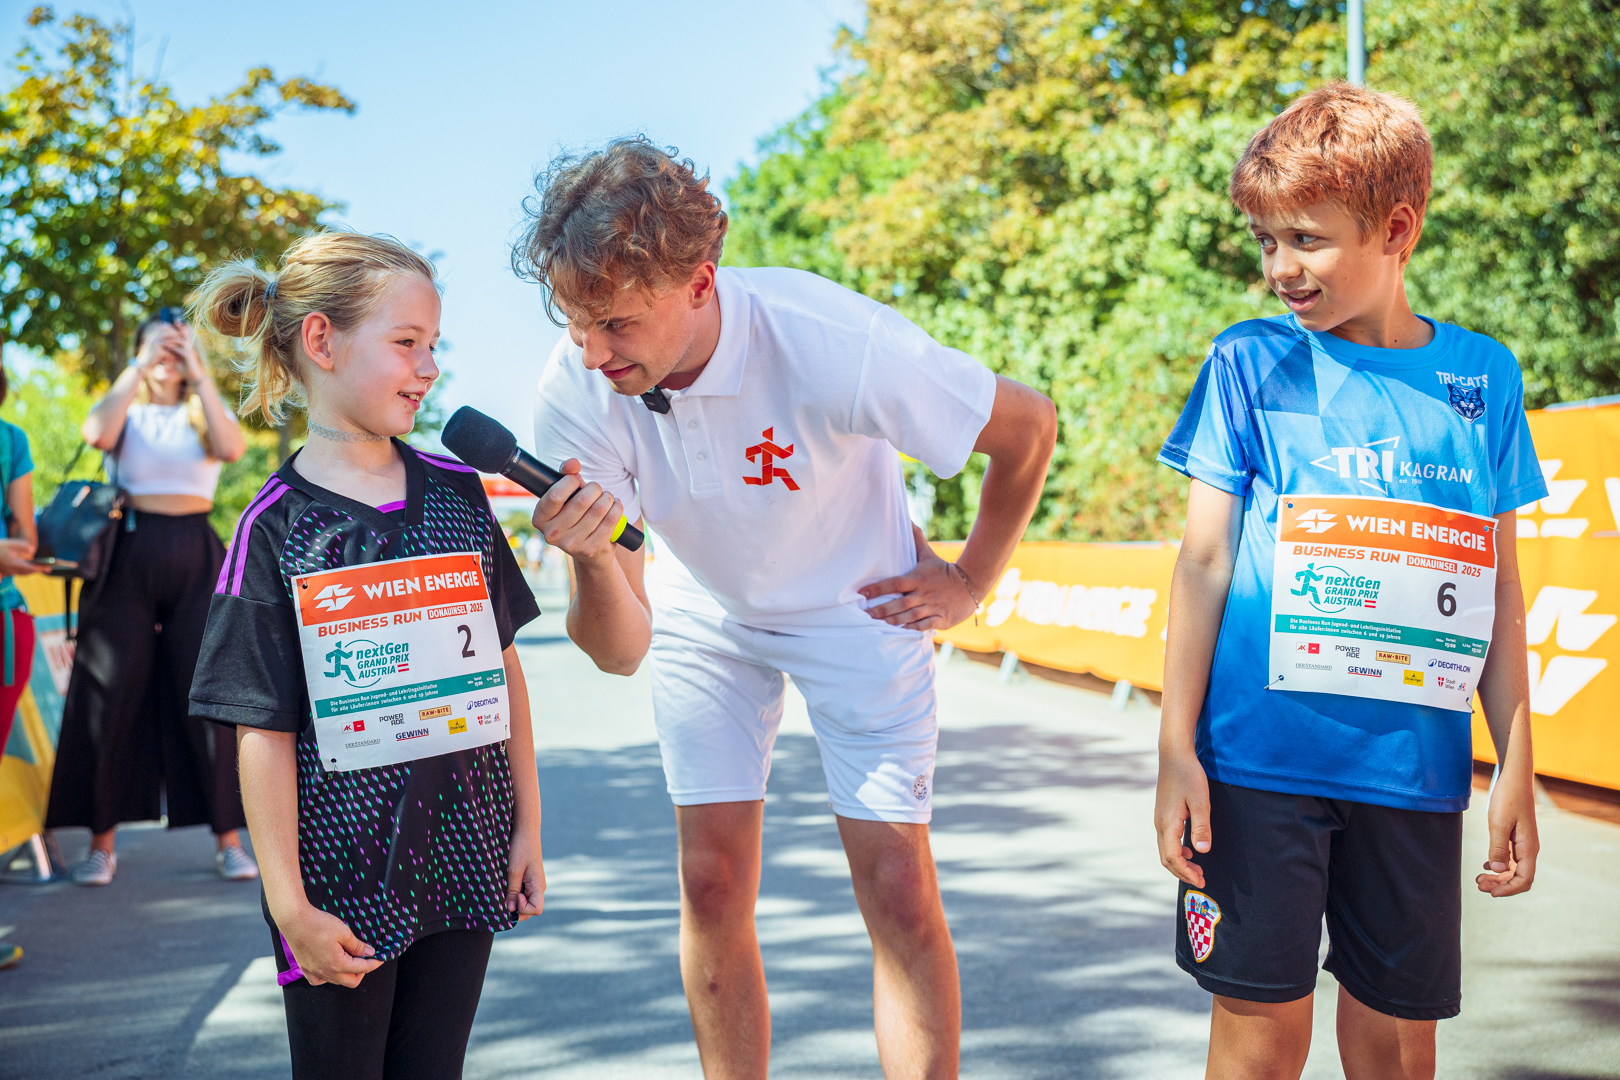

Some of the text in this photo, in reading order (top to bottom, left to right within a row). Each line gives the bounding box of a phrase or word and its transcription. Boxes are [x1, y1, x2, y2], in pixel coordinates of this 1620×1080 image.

[1436, 371, 1488, 389] TRI-CATS
[1331, 447, 1473, 484] TRI KAGRAN
[1346, 515, 1486, 551] WIEN ENERGIE
[1293, 545, 1482, 577] BUSINESS RUN DONAUINSEL 2025
[362, 571, 480, 600] WIEN ENERGIE
[1325, 576, 1381, 590] nextGen
[1325, 586, 1379, 599] GRAND PRIX
[1437, 582, 1457, 617] 6
[1324, 596, 1362, 607] AUSTRIA
[318, 603, 483, 637] BUSINESS RUN DONAUINSEL 2025
[457, 624, 475, 658] 2
[1335, 645, 1360, 653] POWER
[356, 642, 409, 660] nextGen
[357, 653, 409, 669] GRAND PRIX
[1438, 661, 1471, 673] DECATHLON
[359, 665, 396, 679] AUSTRIA
[1348, 666, 1382, 676] GEWINN
[379, 713, 404, 722] POWER
[395, 728, 429, 740] GEWINN
